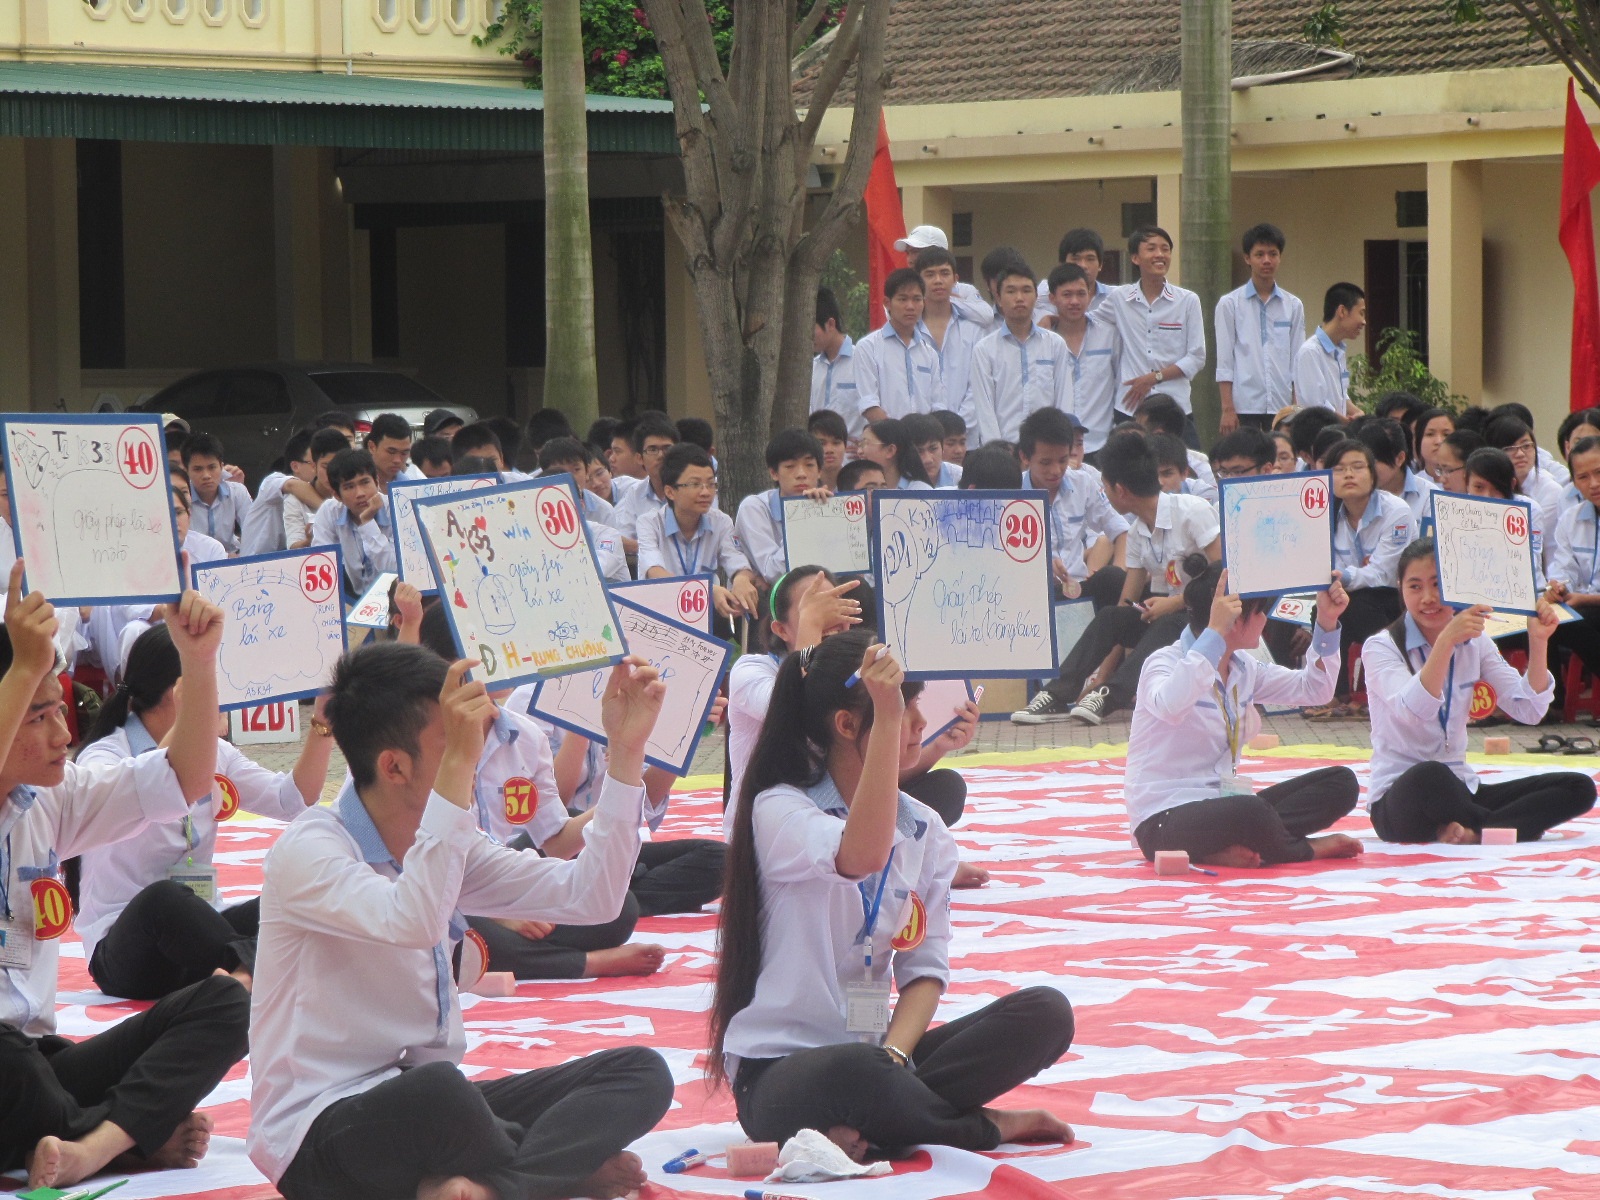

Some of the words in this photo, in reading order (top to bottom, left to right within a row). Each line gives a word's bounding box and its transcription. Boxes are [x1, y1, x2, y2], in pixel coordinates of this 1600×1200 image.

[123, 441, 154, 475] 40
[845, 500, 863, 516] 99
[1304, 487, 1326, 509] 64
[541, 499, 576, 536] 30
[1505, 514, 1526, 537] 63
[1005, 514, 1039, 549] 29
[304, 563, 332, 592] 58
[680, 589, 705, 614] 66
[238, 624, 259, 646] lái
[268, 625, 288, 640] xe
[505, 785, 532, 817] 57
